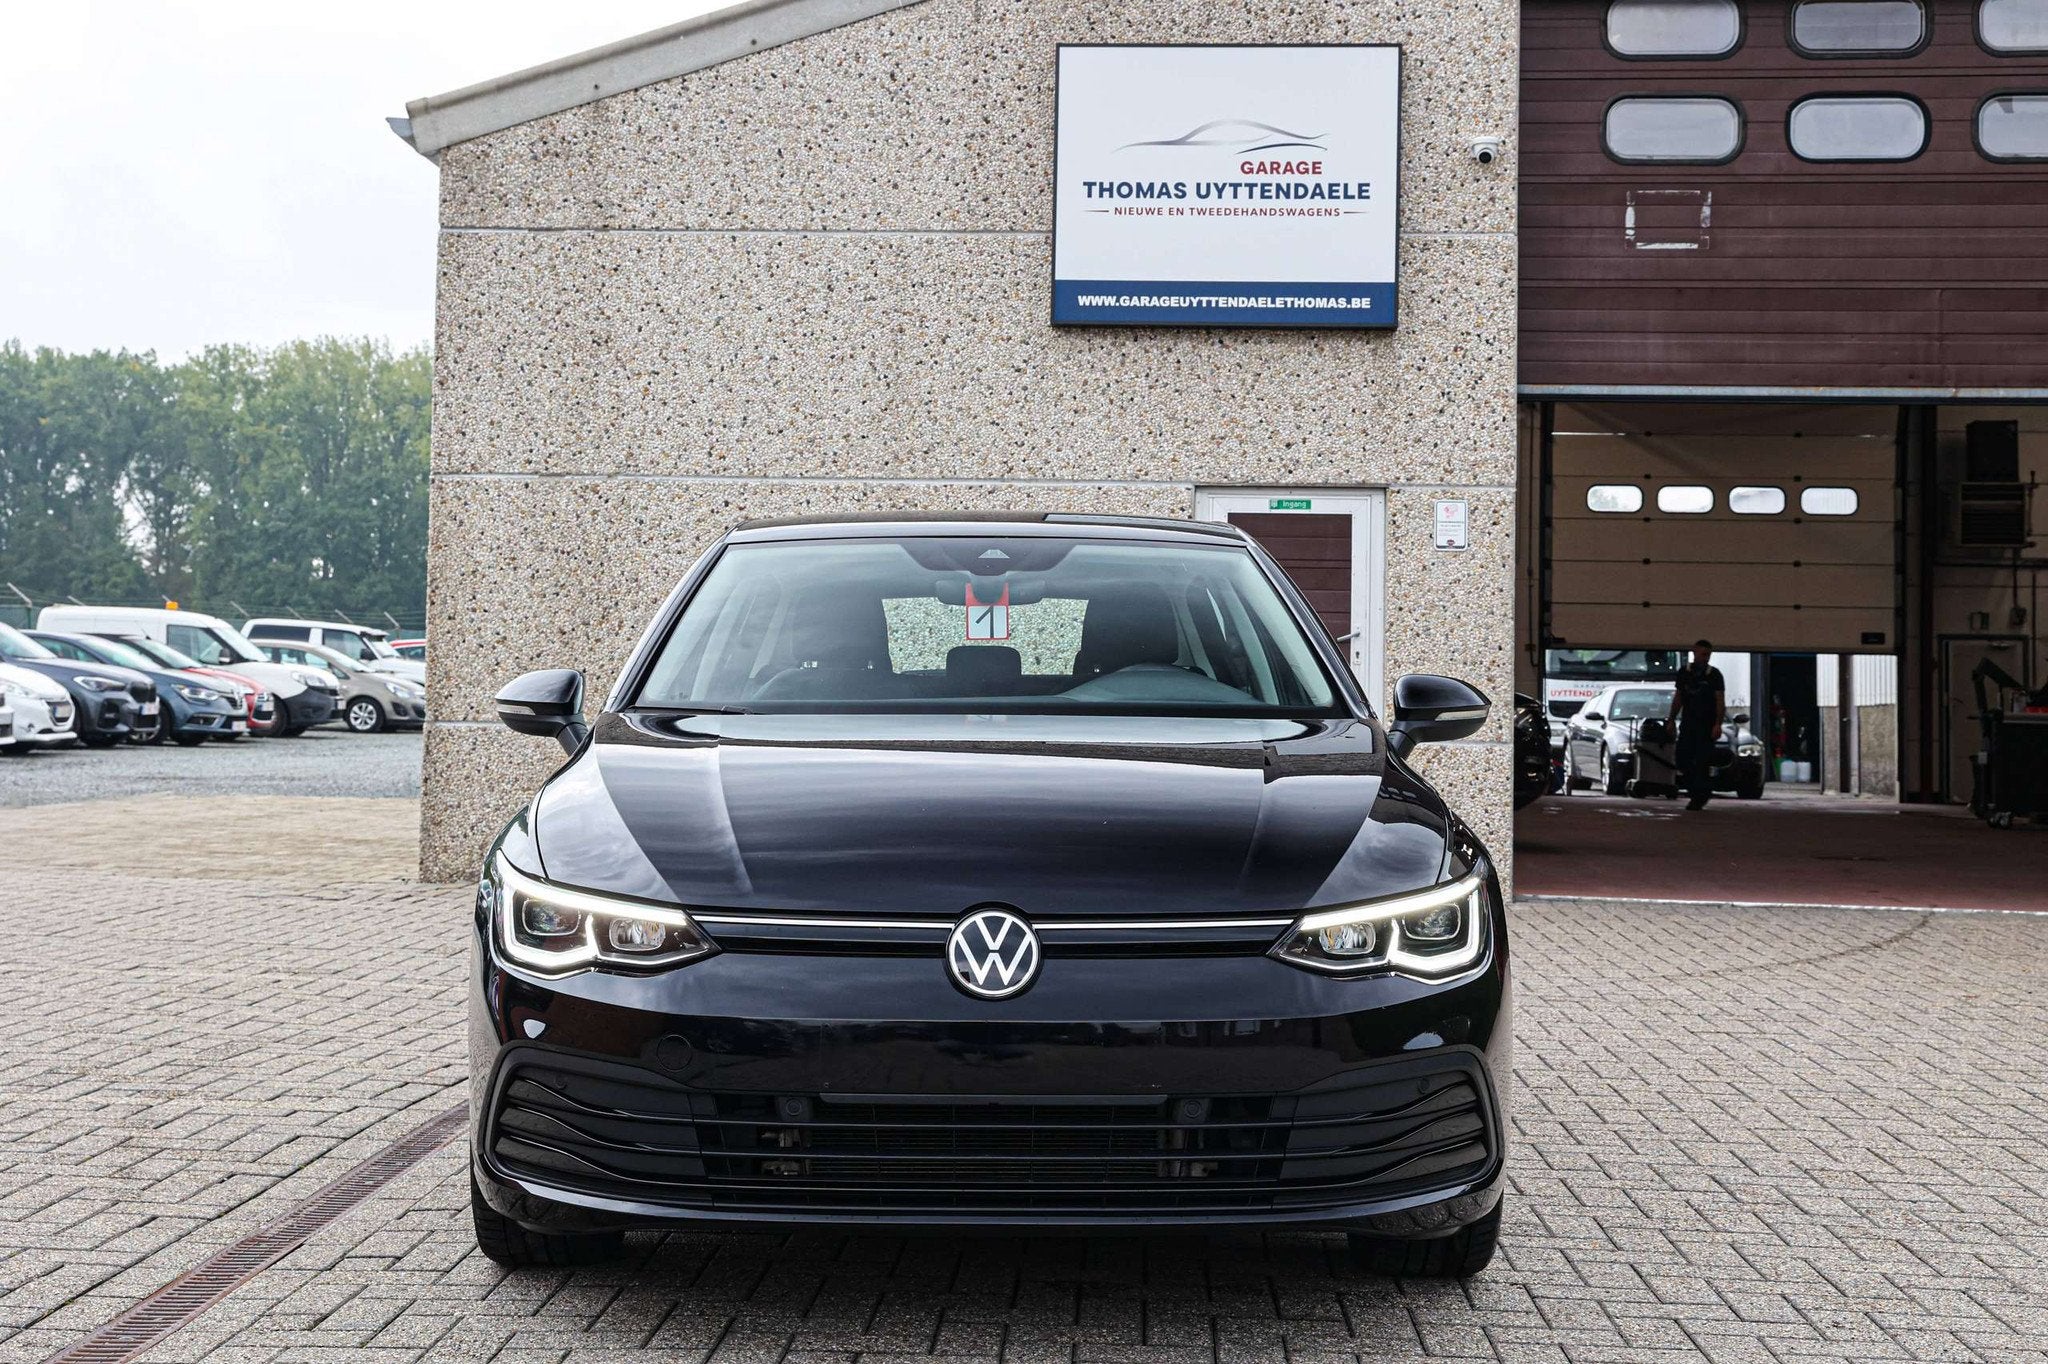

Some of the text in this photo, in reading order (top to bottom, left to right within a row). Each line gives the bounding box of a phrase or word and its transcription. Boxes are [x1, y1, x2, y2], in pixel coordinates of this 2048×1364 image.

[1241, 161, 1323, 175] GARAGE
[1083, 182, 1371, 200] THOMAS UYTTENDAELE
[1114, 207, 1341, 217] NIEUWE EN TWEEDEHANDSWAGENS
[1078, 296, 1371, 309] WWW.GARAGEUYTTENDAELETHOMAS.BE
[1282, 500, 1307, 509] Ingang
[953, 913, 1035, 990] VW
